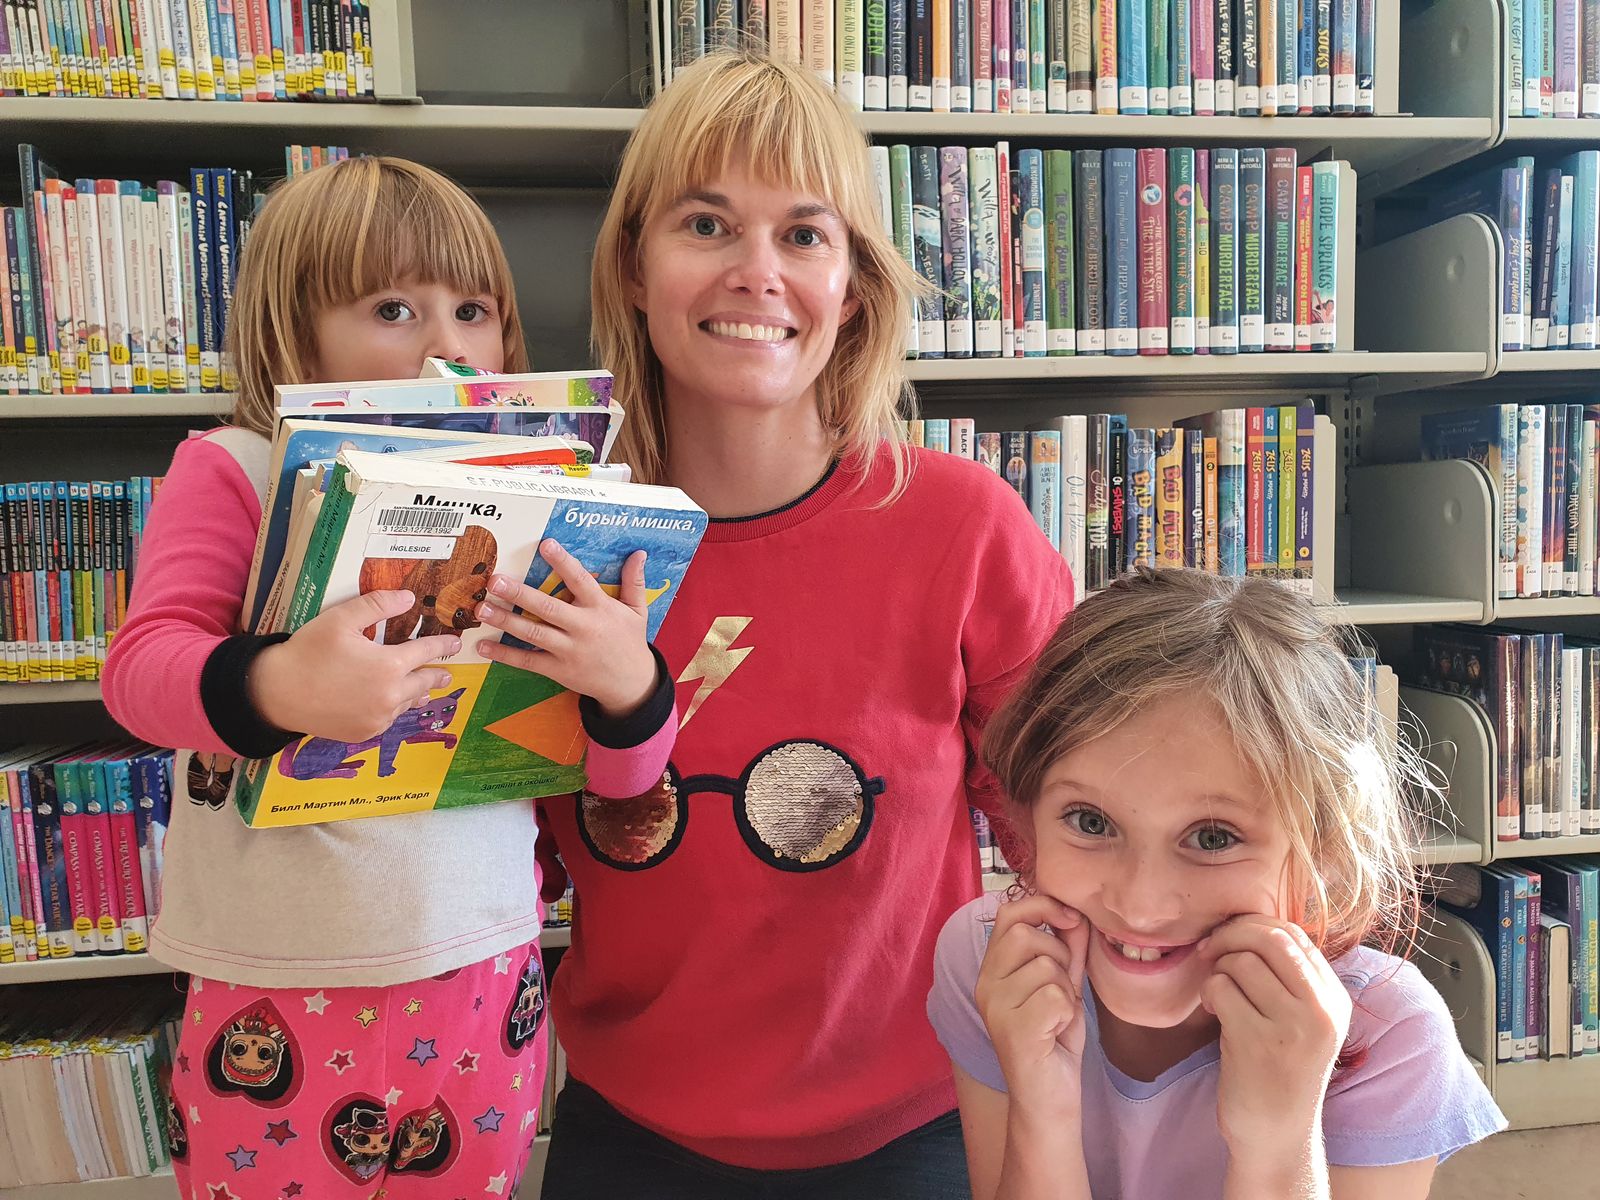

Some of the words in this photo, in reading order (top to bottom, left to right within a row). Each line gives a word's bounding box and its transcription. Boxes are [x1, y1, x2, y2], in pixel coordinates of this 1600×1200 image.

[777, 9, 788, 26] AND
[813, 14, 824, 31] AND
[844, 16, 855, 32] AND
[978, 0, 990, 18] Boy
[1246, 20, 1254, 30] OF
[813, 34, 824, 54] ONLY
[980, 22, 990, 51] Called
[1221, 22, 1228, 33] OF
[844, 36, 855, 55] ONLY
[1218, 37, 1232, 70] HAPPY
[1242, 34, 1256, 68] HAPPY
[1316, 28, 1330, 68] SOCKS
[980, 56, 990, 77] BAT
[1511, 54, 1522, 90] JILLIA
[920, 154, 932, 181] BEATTY
[1088, 176, 1097, 190] The
[948, 166, 966, 206] Willa
[978, 178, 998, 220] Willa
[1277, 179, 1288, 220] CAMP
[196, 200, 206, 244] CAPTAIN
[218, 201, 228, 244] CAPTAIN
[901, 204, 911, 230] Little
[1219, 184, 1232, 230] CAMP
[1246, 183, 1258, 230] CAMP
[1320, 196, 1334, 230] HOPE
[951, 217, 966, 240] DARK
[1142, 217, 1155, 240] FIRE
[1176, 210, 1188, 244] SECRET
[85, 236, 95, 272] Completely
[1055, 246, 1070, 274] BRAIN
[1143, 243, 1154, 254] IN
[1180, 248, 1188, 258] IN
[1276, 221, 1288, 288] MURDERFACE
[1318, 235, 1334, 288] SPRINGS
[198, 243, 212, 299] UNDERPANTS
[220, 244, 232, 299] UNDERPANTS
[952, 247, 965, 288] HOLLOW
[1088, 254, 1098, 290] BIRDIE
[1119, 265, 1128, 294] PIPPA
[1143, 258, 1154, 274] THE
[1155, 272, 1163, 293] QUEST
[1218, 234, 1232, 312] MURDERFACE
[1245, 232, 1259, 310] MURDERFACE
[1300, 251, 1308, 296] WINSTON
[1524, 258, 1532, 297] Cloudy
[72, 280, 82, 317] Clementine
[88, 273, 98, 308] Clementine
[1057, 280, 1069, 318] ROBBERY
[1142, 278, 1156, 303] STAR
[1176, 282, 1188, 312] STONE
[1252, 449, 1262, 472] ZEUS
[1266, 449, 1276, 472] ZEUS
[1283, 449, 1293, 472] ZEUS
[1301, 448, 1310, 471] ZEUS
[263, 482, 274, 519] LIBRARY
[494, 479, 542, 492] PUBLIC
[542, 484, 596, 497] LIBRARY
[1134, 471, 1152, 508] BAD
[1164, 466, 1182, 502] BAD
[320, 503, 333, 529] Карл
[565, 507, 628, 528] бурый
[631, 516, 697, 534] мишка,
[1112, 486, 1125, 534] SHIVERS!
[1192, 508, 1202, 539] OLIVER
[1503, 472, 1516, 544] SHELTERLINGS
[1568, 494, 1579, 530] DRAGON
[321, 510, 340, 555] Мартин
[390, 544, 431, 553] INGLESIDE
[1088, 518, 1107, 550] HYDE
[1132, 515, 1152, 566] MAGIC
[1164, 510, 1180, 560] NEWS
[282, 560, 290, 577] SAN
[266, 576, 283, 618] FRANCISCO
[480, 782, 516, 792] Загляни
[524, 775, 559, 786] окошко!
[270, 805, 300, 814] Билл
[303, 800, 346, 812] Мартин
[349, 798, 372, 806] Мл.,
[375, 794, 402, 804] Эрик
[404, 792, 430, 802] Карл
[93, 831, 104, 870] COMPASS
[120, 840, 130, 880] TREASURE
[46, 838, 54, 863] DANCE
[50, 882, 58, 900] STAR
[68, 831, 79, 871] COMPASS
[76, 892, 86, 918] STARS
